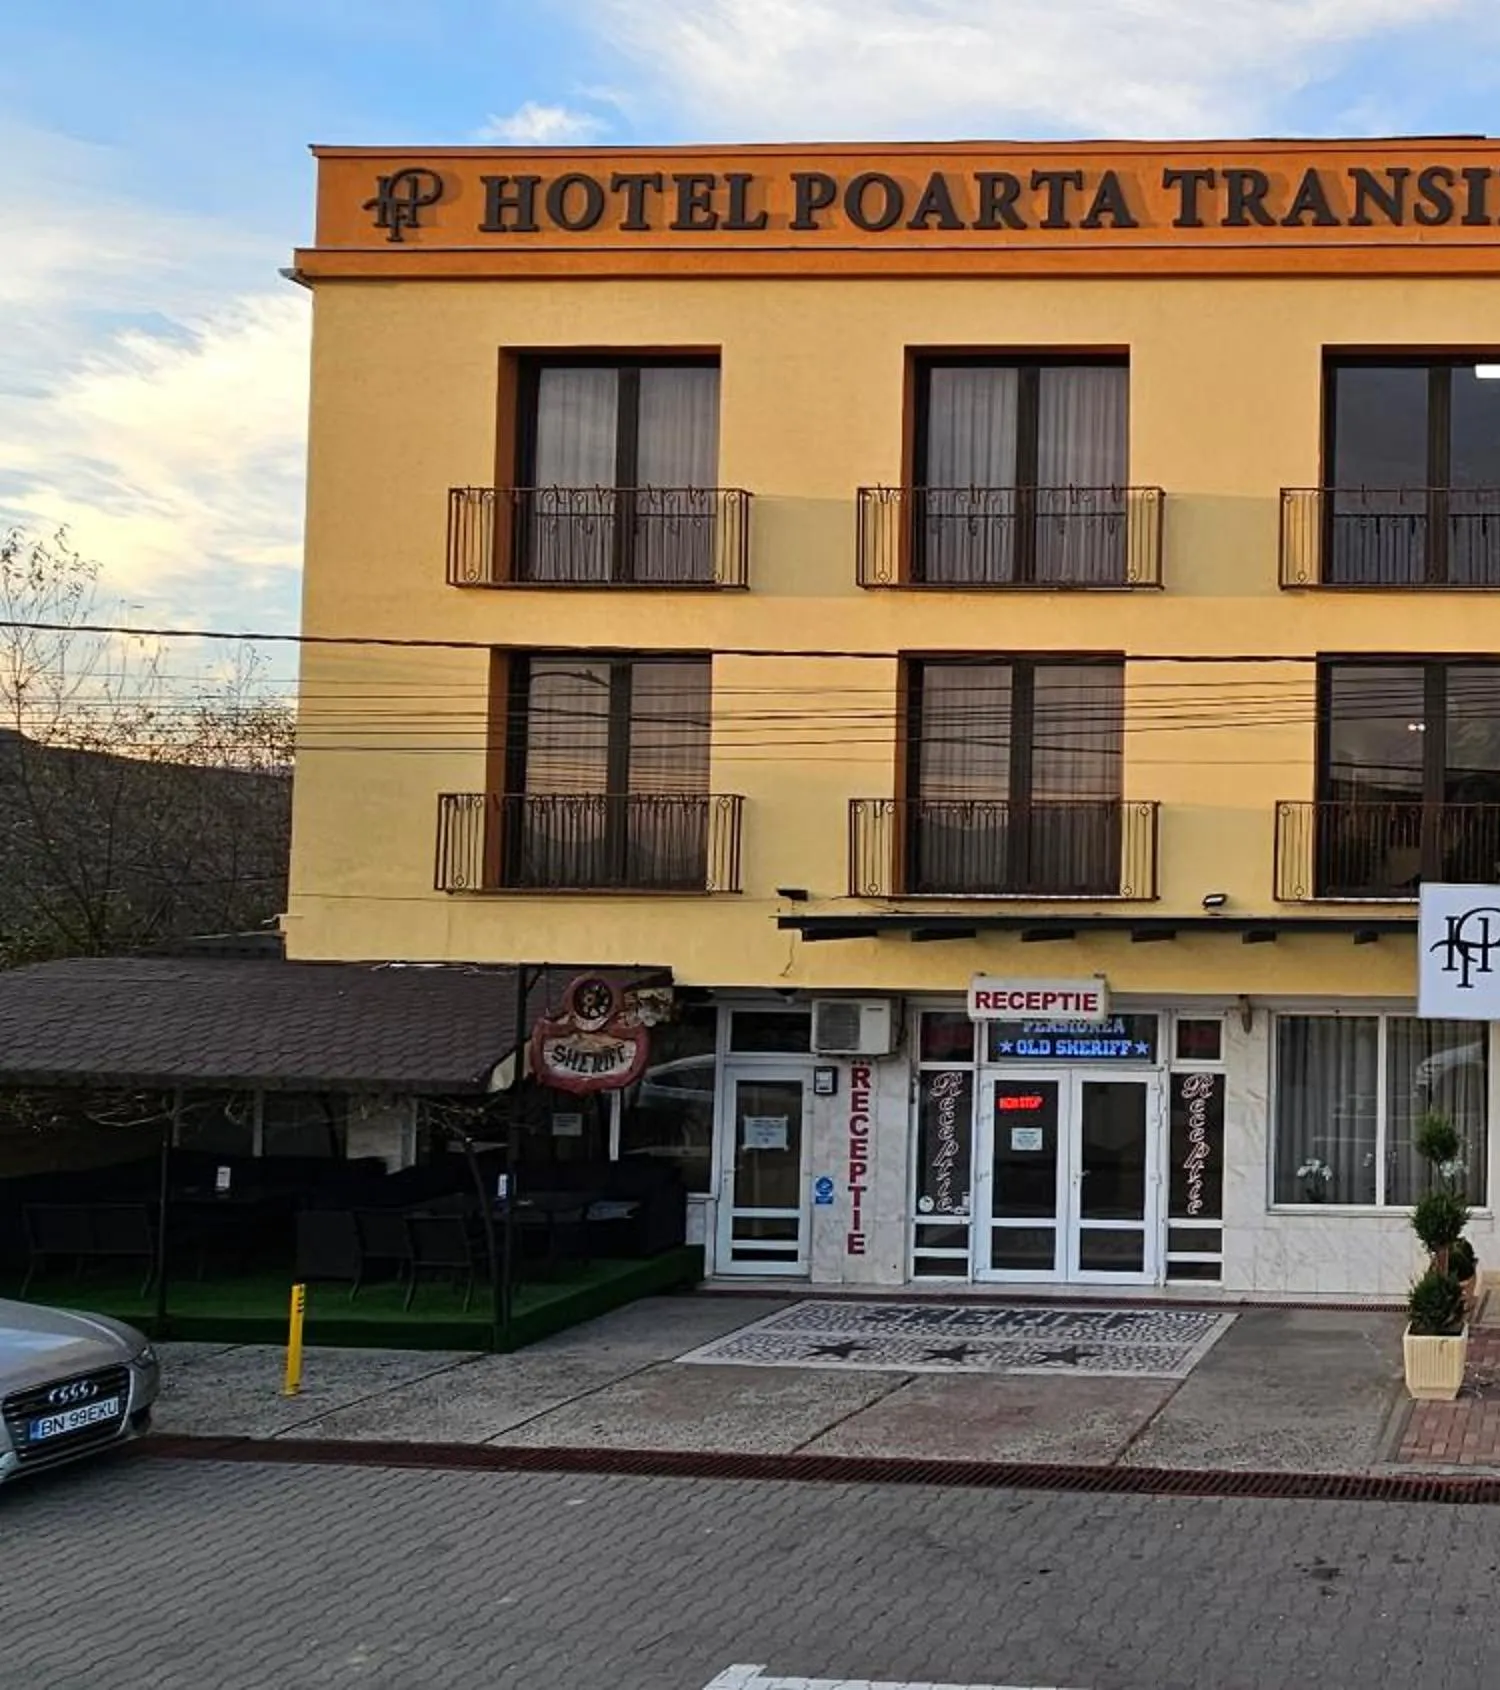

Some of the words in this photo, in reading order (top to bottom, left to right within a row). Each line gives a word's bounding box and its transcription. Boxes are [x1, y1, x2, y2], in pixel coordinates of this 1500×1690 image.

[478, 171, 769, 233] HOTEL
[789, 168, 1139, 232] POARTA
[975, 991, 1099, 1011] RECEPTIE
[1016, 1040, 1051, 1056] OLD
[1055, 1040, 1133, 1057] SHERIFF
[848, 1066, 871, 1255] RECEPTIE
[41, 1416, 65, 1437] BN
